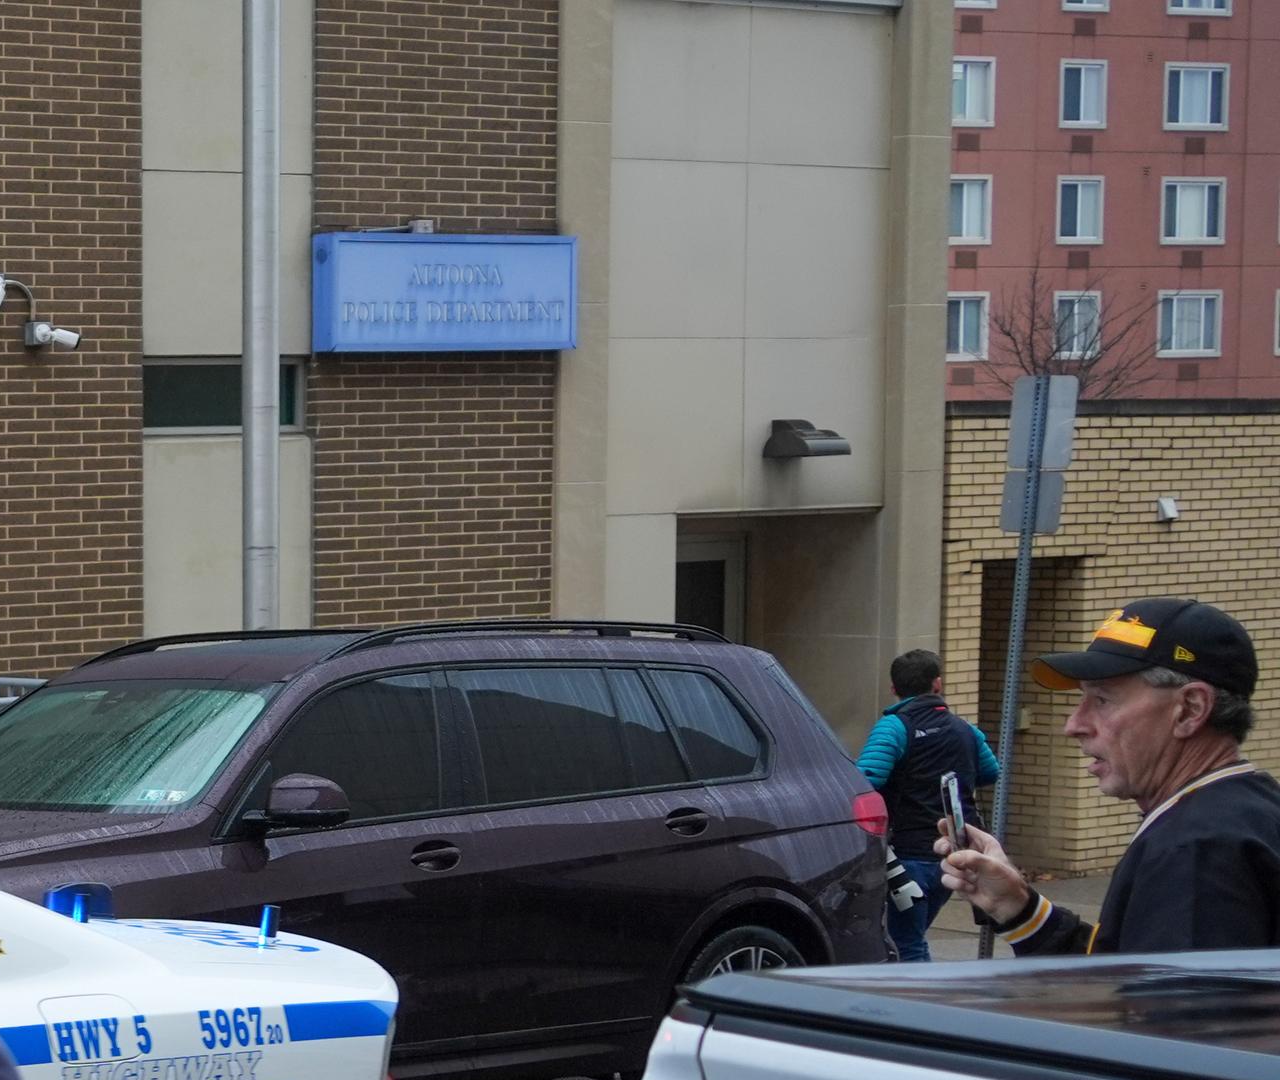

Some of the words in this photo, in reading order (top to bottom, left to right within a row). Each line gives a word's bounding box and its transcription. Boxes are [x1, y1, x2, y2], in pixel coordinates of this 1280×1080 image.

[342, 301, 417, 323] POLICE
[427, 300, 564, 323] DEPARTMENT
[53, 1017, 121, 1061] HWY
[132, 1014, 153, 1054] 5
[197, 1006, 265, 1049] 5967
